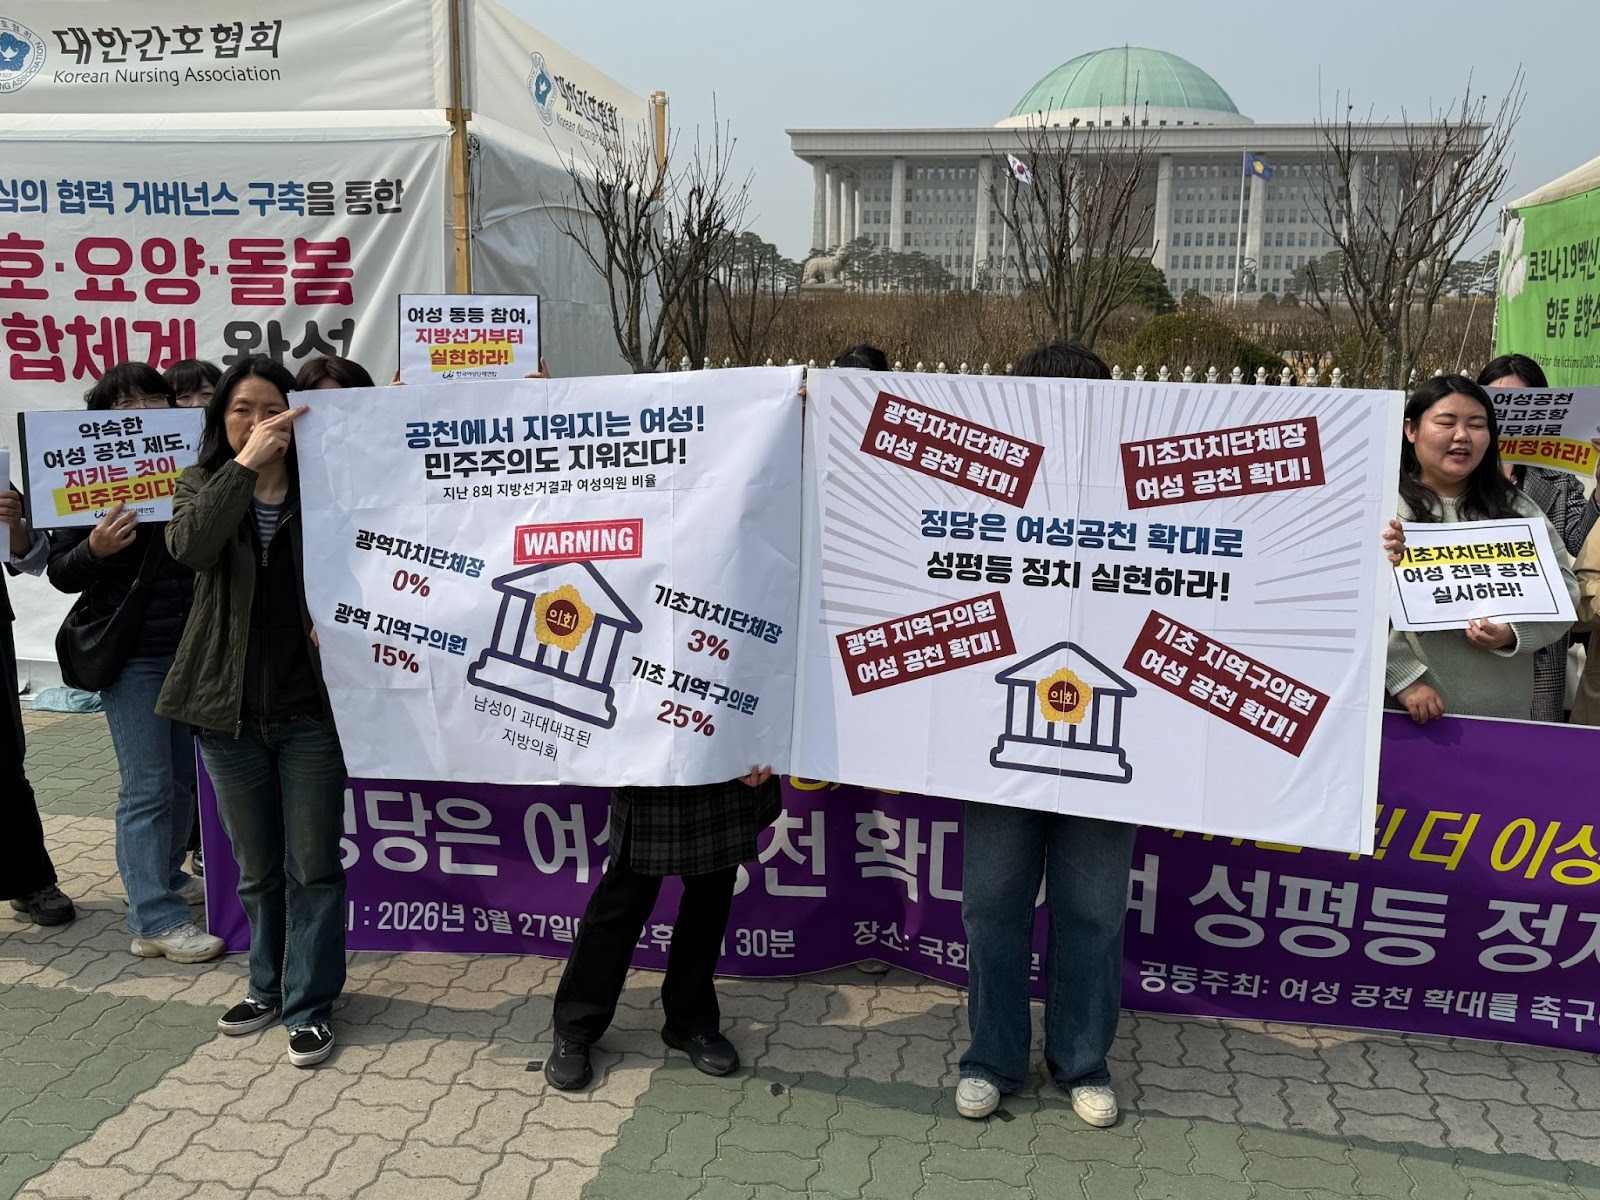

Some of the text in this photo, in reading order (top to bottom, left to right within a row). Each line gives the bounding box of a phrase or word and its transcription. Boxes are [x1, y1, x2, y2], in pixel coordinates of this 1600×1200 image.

[52, 20, 282, 65] 대한간호협회
[12, 41, 44, 88] ASSOCIATION
[53, 66, 281, 87] Korean Nursing Association
[56, 179, 115, 215] 협력
[123, 181, 240, 216] 거버넌스
[248, 181, 335, 217] 구축을
[345, 178, 404, 216] 통한
[1528, 237, 1600, 283] 코로나19백신
[407, 307, 531, 325] 여성 동등 참여,
[415, 328, 524, 345] 지방선거부터
[1546, 297, 1570, 339] 합동
[430, 349, 509, 366] 실현하라!
[1493, 392, 1574, 406] 여성공천
[78, 416, 143, 440] 약속한
[405, 405, 705, 449] 공천에서 지워지는 여성!
[883, 400, 1030, 469] 광역자치단체장
[1131, 422, 1307, 469] 기초자치단체장
[1498, 424, 1562, 437] 무화로
[43, 433, 191, 468] 여성 공천 제도,
[425, 438, 687, 480] 민주주의도 지워진다!
[875, 432, 1019, 498] 여성 공천 확대!
[64, 456, 177, 489] 지키는 것이
[443, 473, 657, 500] 지난 8회 지방선거결과 여성의원 비율
[1135, 457, 1311, 502] 여성 공천 확대!
[67, 478, 177, 512] 민주주의다
[356, 529, 485, 578] 광역자치단체장
[524, 526, 633, 556] WARNING
[921, 509, 1243, 558] 정당은 여성공천 확대로
[392, 569, 431, 597] 0%
[927, 550, 1229, 602] 성평등 정치 실현하라!
[1403, 562, 1539, 583] 여성 전략 공천
[1432, 582, 1524, 604] 실시하라!
[334, 603, 467, 656] 광역 지역구의원
[549, 609, 577, 630] 의회
[655, 584, 783, 644] 기초자치단체장
[845, 598, 996, 655] 광역 지역구의원
[372, 643, 419, 673] 15%
[688, 629, 730, 660] 3%
[857, 630, 1002, 684] 여성 공천 확대!
[631, 656, 759, 715] 기초 지역구의원
[1154, 617, 1317, 717] 기초 지역구의원
[1049, 689, 1078, 707] 의회
[1140, 648, 1297, 743] 여성 공천 확대!
[474, 695, 592, 749] 남성이 과대대표된
[657, 700, 715, 737] 25%
[502, 728, 558, 762] 지방의회
[1409, 810, 1481, 872] 더
[377, 901, 465, 933] 2026년
[472, 906, 513, 936] 3월
[735, 928, 795, 958] 30분
[853, 920, 911, 952] 장소:
[1189, 864, 1449, 967] 성평등
[1140, 960, 1600, 1033] 공동주최: 여성 공천 확대를 촉구
